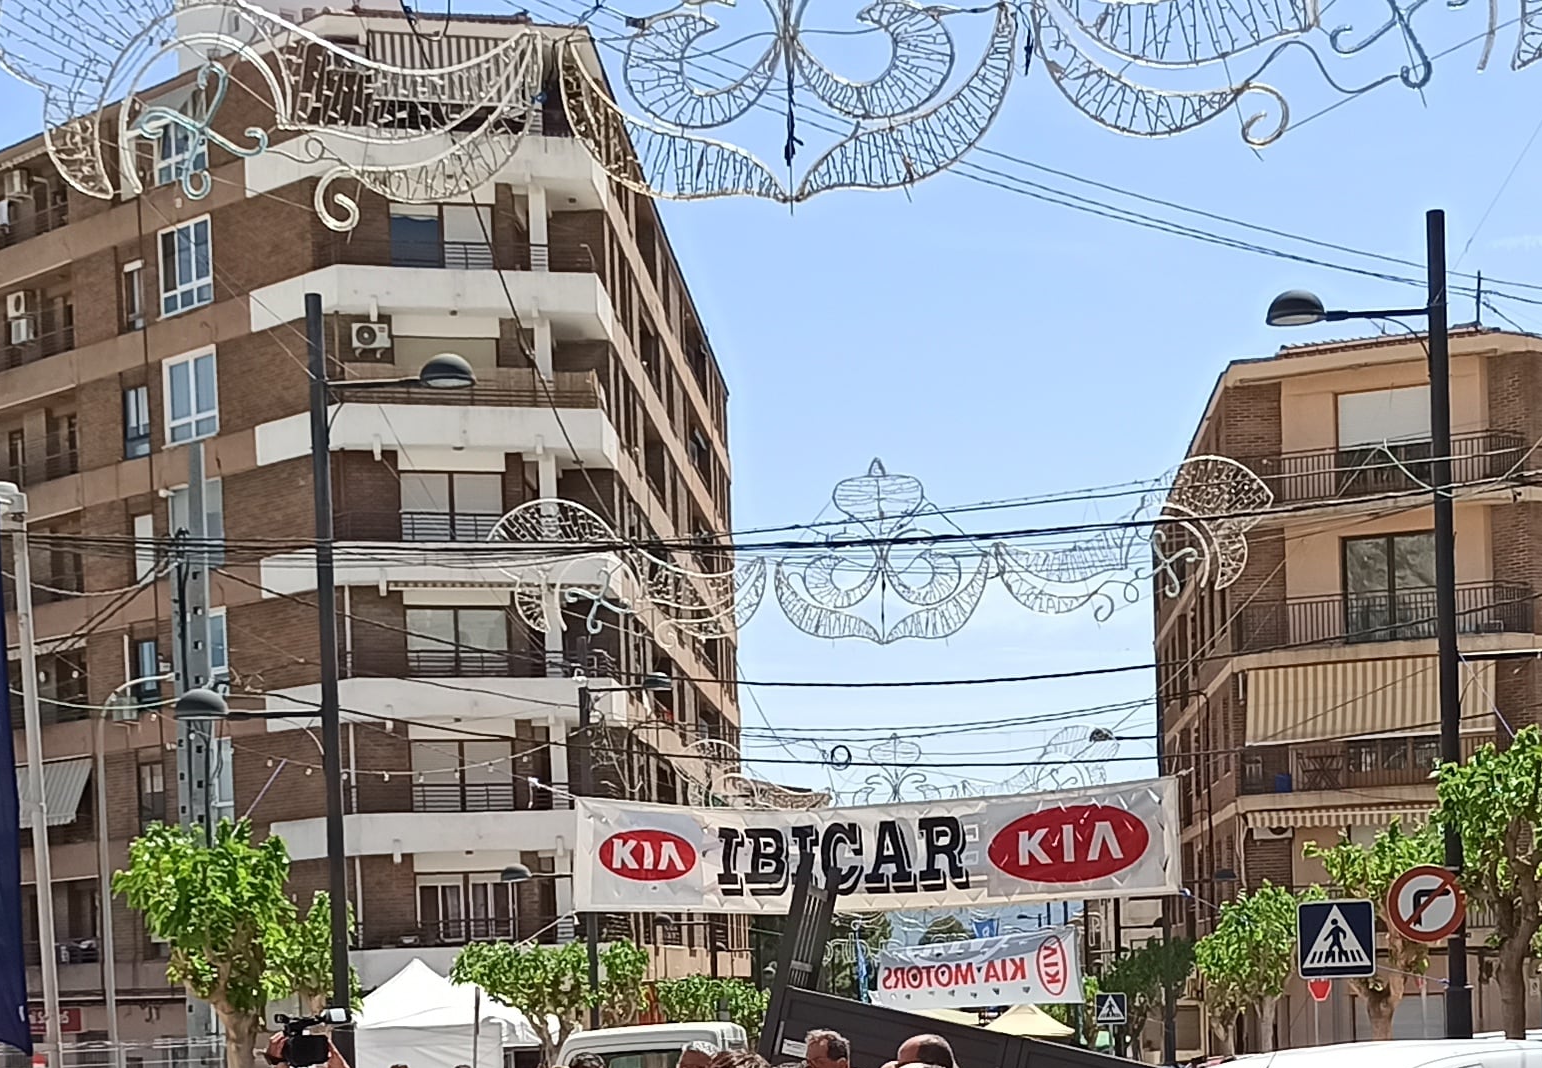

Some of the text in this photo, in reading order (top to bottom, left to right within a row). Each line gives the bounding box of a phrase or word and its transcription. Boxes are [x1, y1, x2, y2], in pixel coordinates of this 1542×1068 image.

[612, 838, 686, 873] KIA
[717, 816, 970, 896] IBICAR
[1018, 821, 1124, 866] KIA
